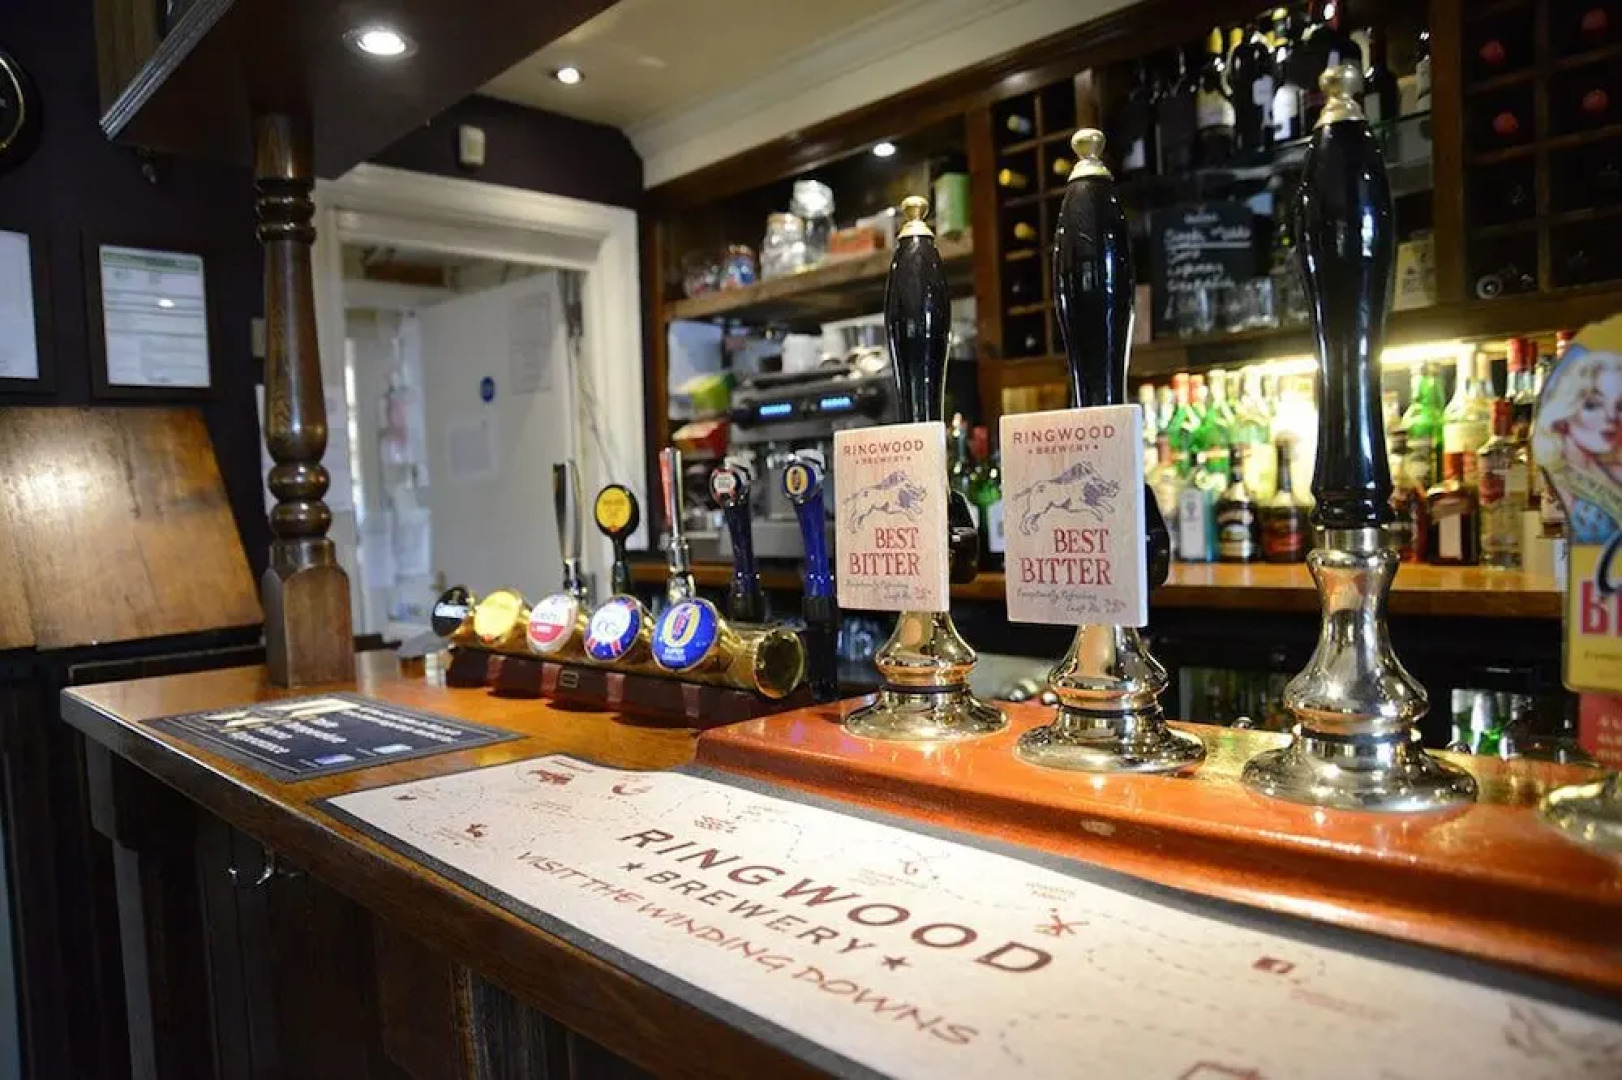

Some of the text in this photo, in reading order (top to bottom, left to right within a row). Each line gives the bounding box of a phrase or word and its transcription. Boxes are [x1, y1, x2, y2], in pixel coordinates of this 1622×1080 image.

[1012, 424, 1115, 444] RINGWOOD
[843, 440, 924, 456] RINGWOOD
[1036, 443, 1091, 455] BREWERY
[875, 527, 919, 549] BEST
[1053, 529, 1109, 554] BEST
[849, 552, 921, 576] BITTER
[1019, 557, 1112, 586] BITTER
[617, 828, 1053, 974] RINGWOOD
[643, 869, 877, 954] BREWERY
[515, 850, 979, 1045] VISIT THE WINDING DOWNS
